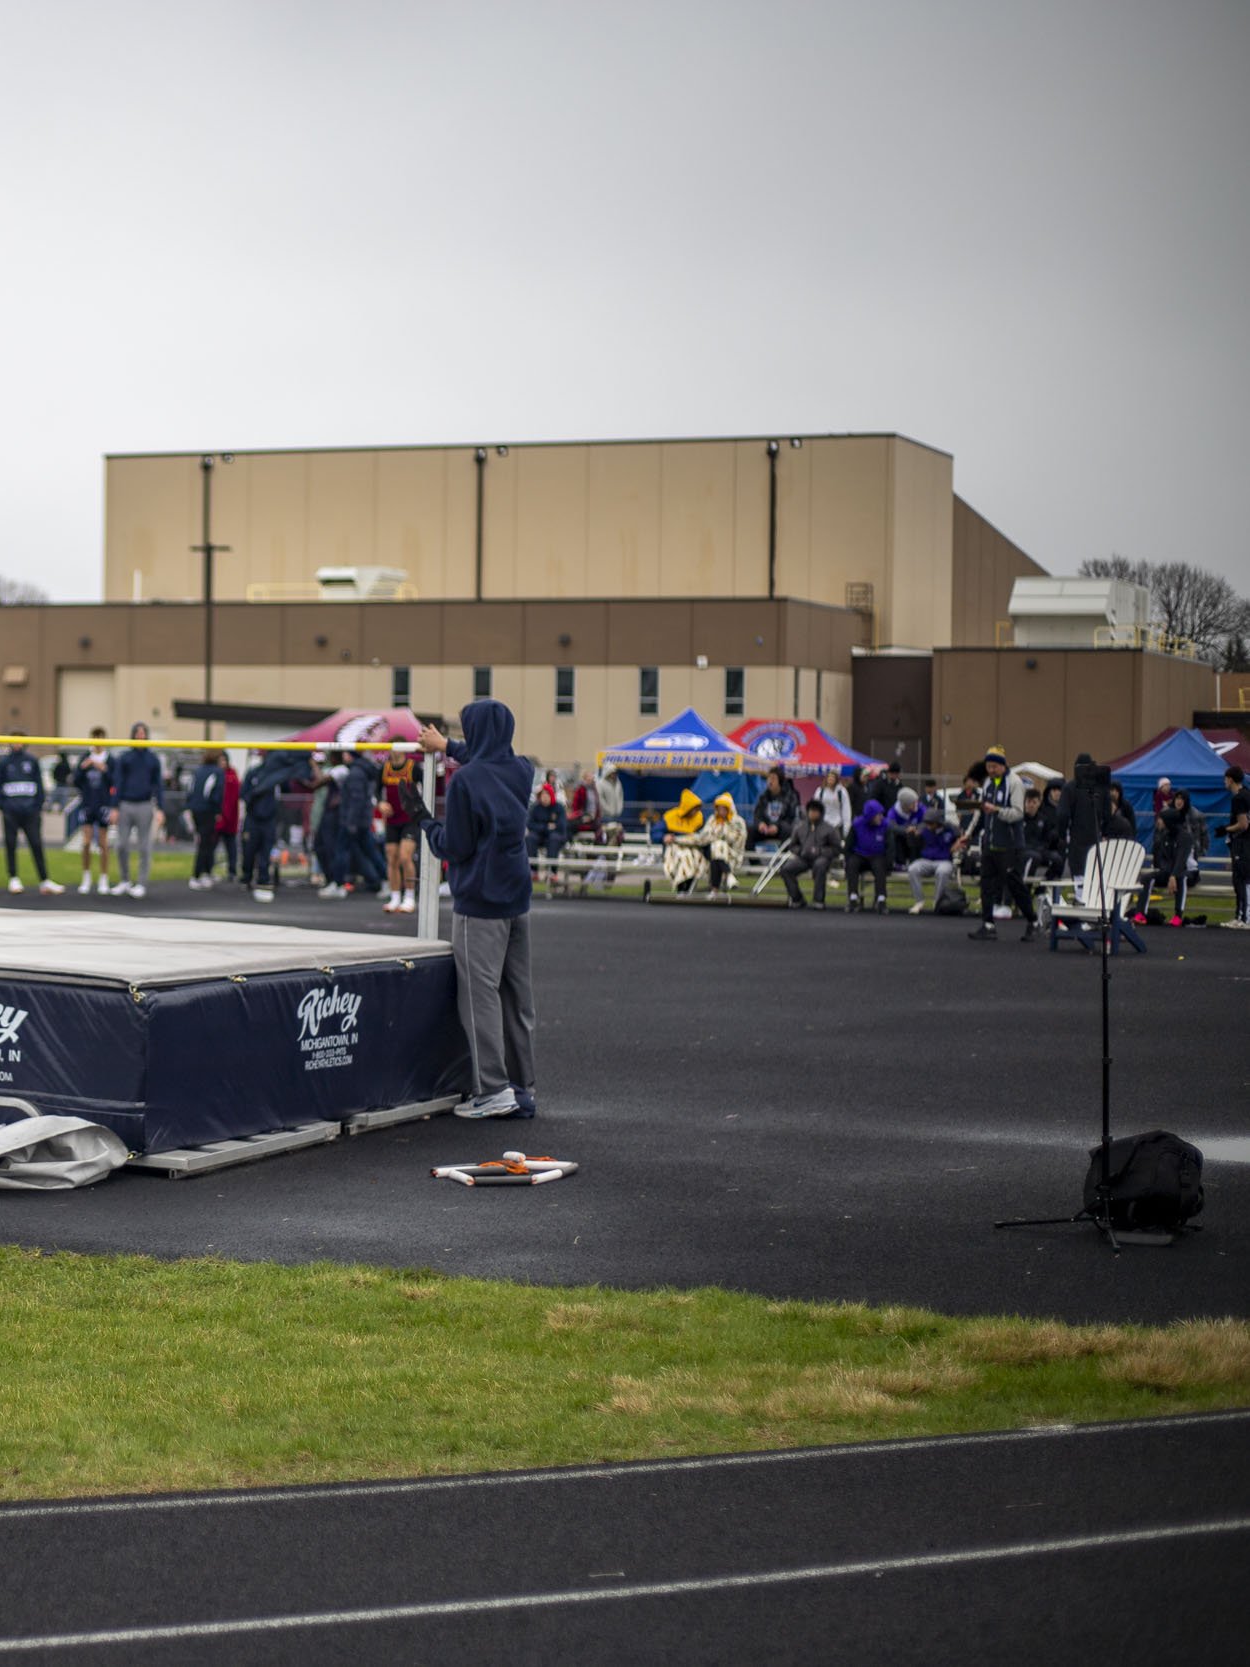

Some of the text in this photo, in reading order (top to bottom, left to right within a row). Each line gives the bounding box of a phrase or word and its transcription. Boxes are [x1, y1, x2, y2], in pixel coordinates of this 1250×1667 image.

[296, 984, 362, 1042] Richey
[300, 1032, 358, 1051] MICHIGANTOWN, IN
[8, 1049, 21, 1062] IN
